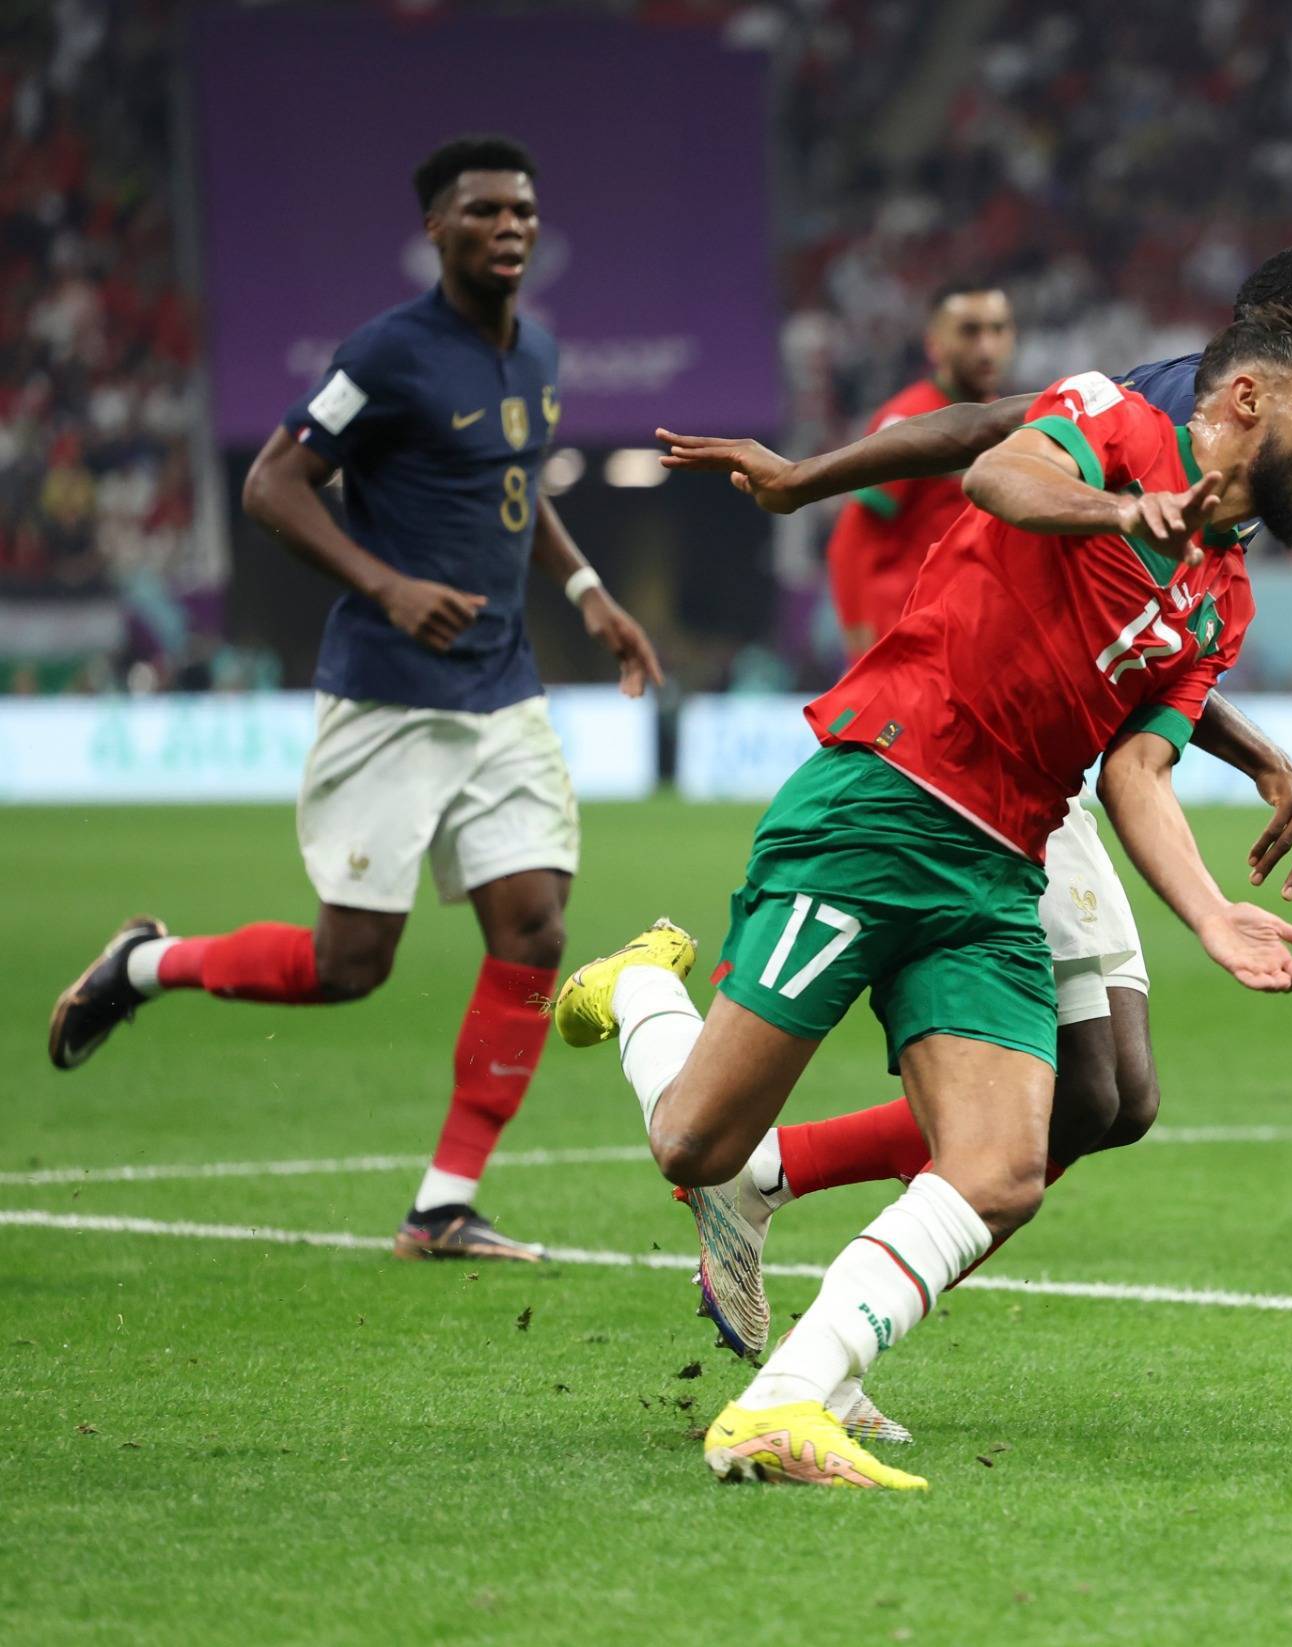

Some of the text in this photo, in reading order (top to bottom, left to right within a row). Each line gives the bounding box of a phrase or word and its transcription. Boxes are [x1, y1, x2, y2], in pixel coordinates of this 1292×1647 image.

[500, 465, 529, 533] 8
[1095, 597, 1182, 685] 17
[758, 892, 862, 1000] 17
